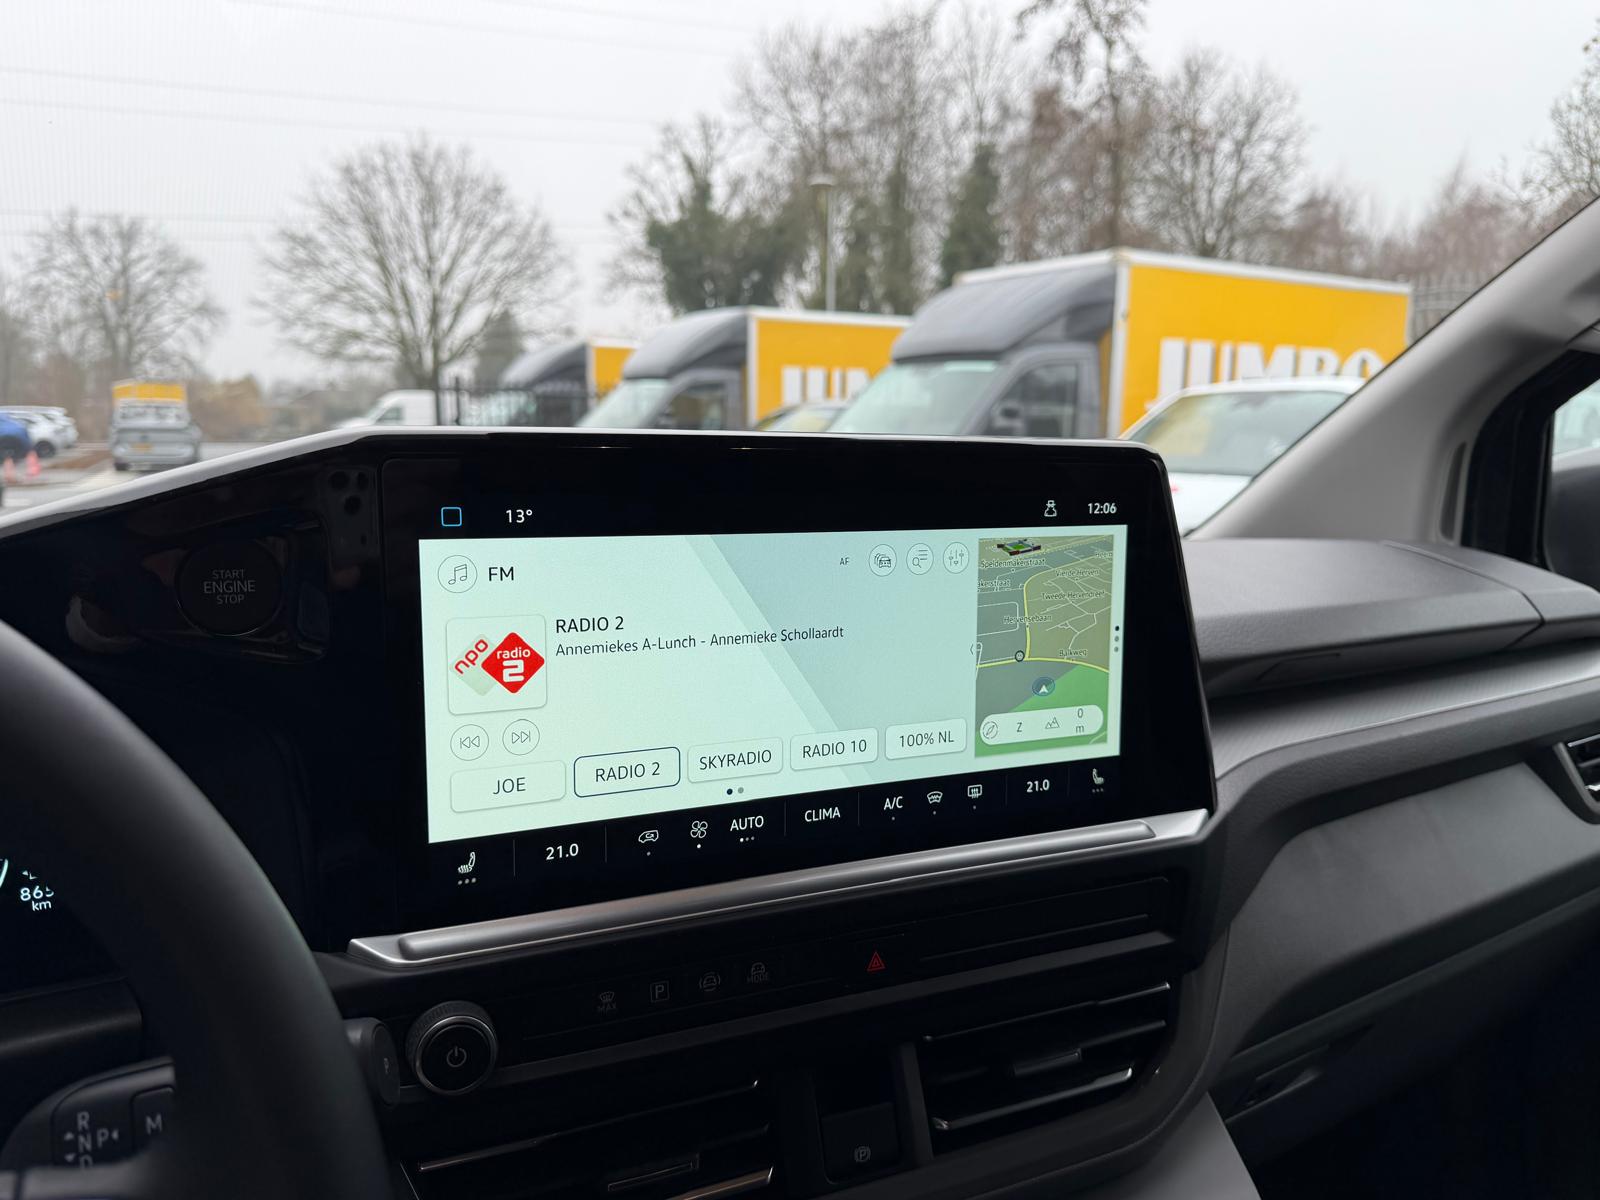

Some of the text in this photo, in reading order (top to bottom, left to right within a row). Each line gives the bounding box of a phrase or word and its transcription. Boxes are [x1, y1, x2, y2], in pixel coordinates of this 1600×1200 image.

[505, 509, 533, 524] 13°
[1087, 502, 1117, 515] 12:06
[839, 556, 850, 566] AF
[212, 569, 245, 580] START
[488, 566, 515, 582] FM
[203, 579, 257, 594] ENGINE
[216, 593, 245, 605] STOP
[555, 615, 625, 634] RADIO 2
[555, 639, 638, 657] Annemiekes
[642, 635, 696, 651] A-Lunch
[710, 630, 777, 647] Annemieke
[780, 626, 844, 642] Schollaardt
[454, 638, 488, 675] npo
[496, 646, 531, 659] radio
[502, 659, 525, 683] 2
[1016, 722, 1023, 733] Z
[1075, 725, 1085, 733] m
[898, 730, 955, 749] 100% NL
[802, 739, 868, 759] RADIO 10
[698, 749, 773, 772] SKYRADIO
[594, 761, 661, 783] RADIO 2
[492, 776, 527, 796] JOE
[1026, 779, 1050, 793] 21.0
[883, 795, 904, 811] A/C
[804, 806, 841, 823] CLIMA
[729, 815, 765, 832] AUTO
[545, 843, 580, 860] 21.0
[32, 900, 52, 912] km
[76, 1110, 91, 1132] R
[145, 1112, 163, 1136] M
[77, 1132, 93, 1153] N
[96, 1127, 110, 1149] P
